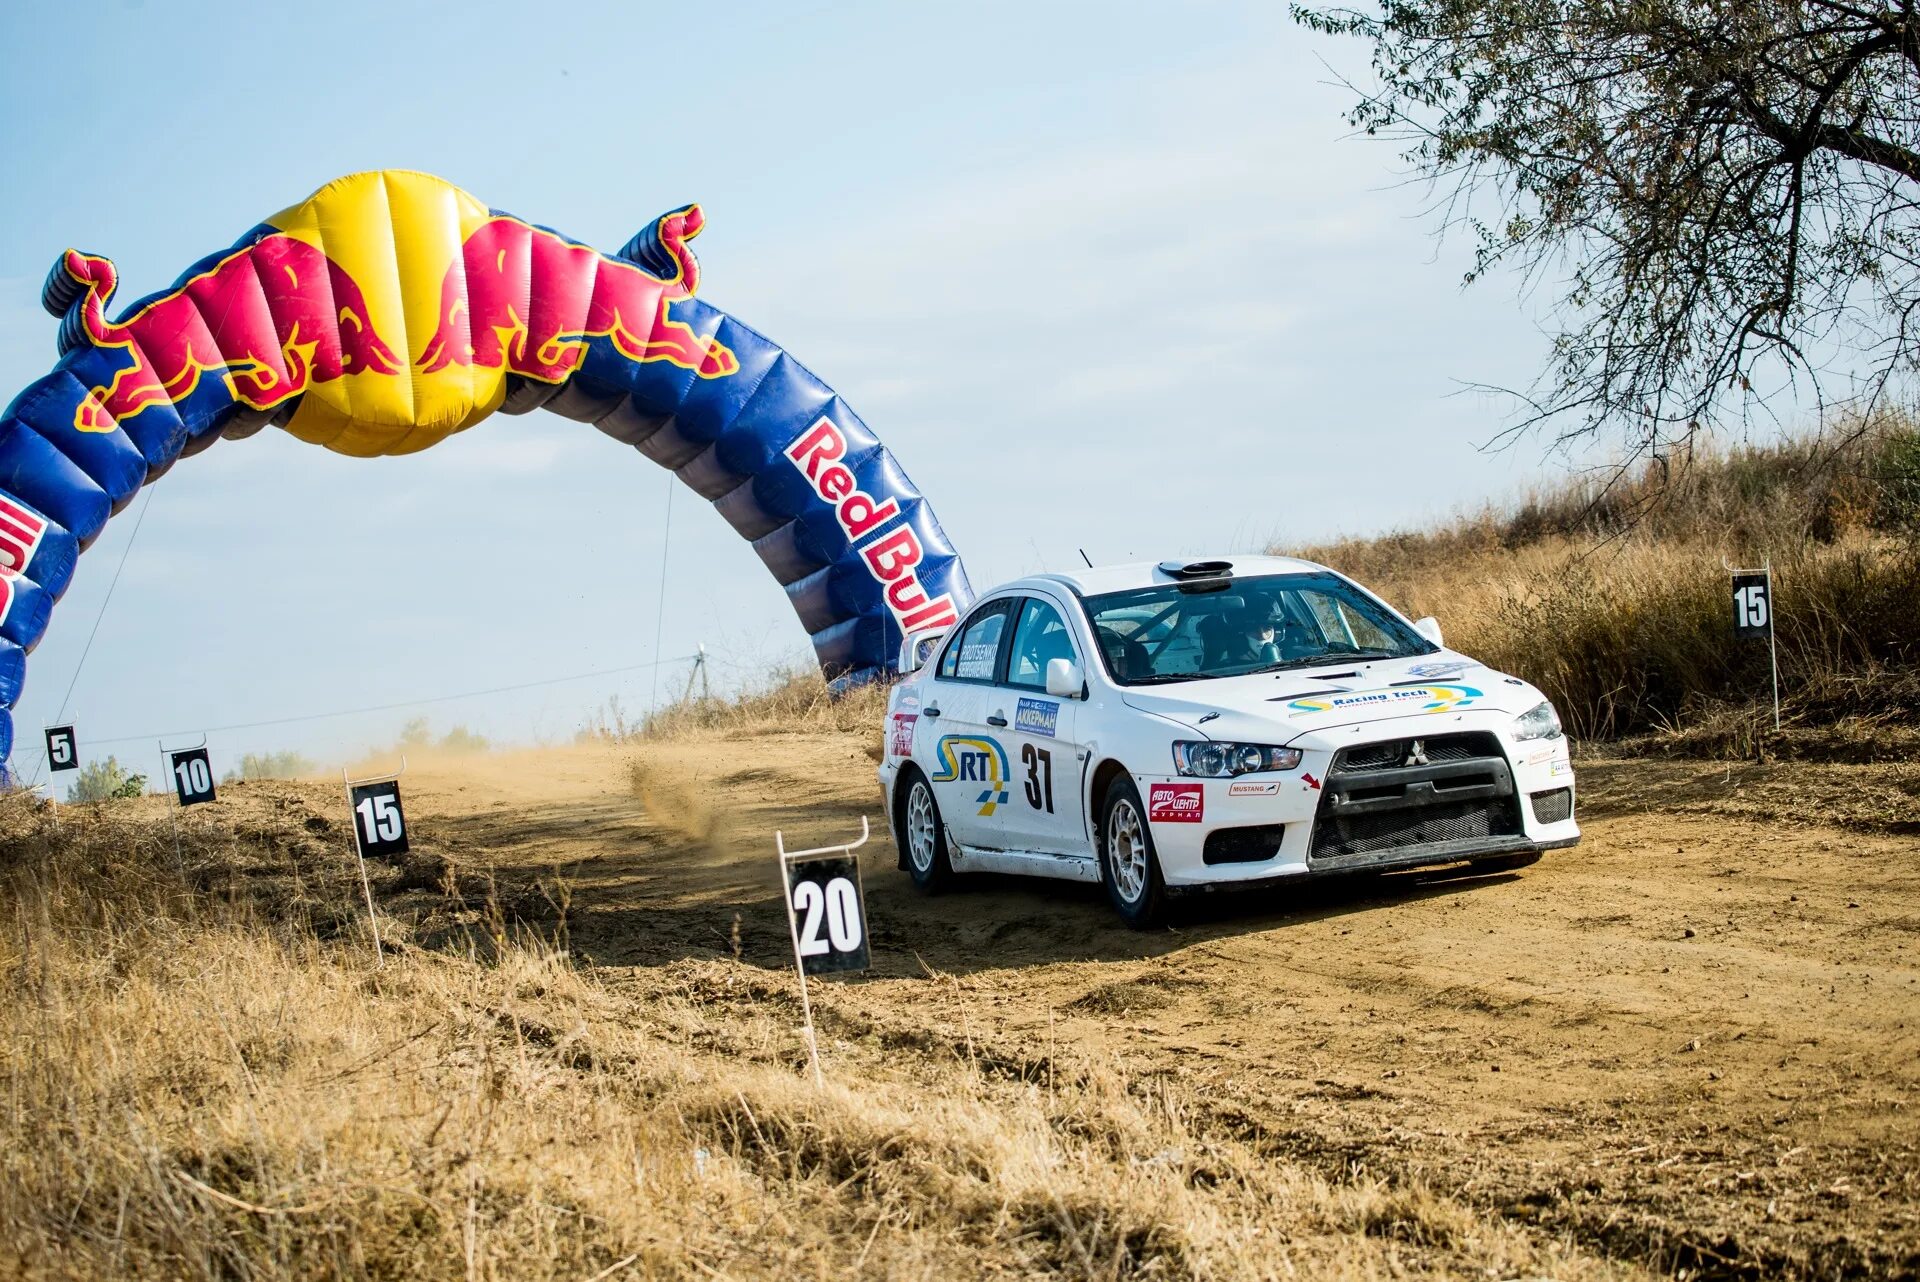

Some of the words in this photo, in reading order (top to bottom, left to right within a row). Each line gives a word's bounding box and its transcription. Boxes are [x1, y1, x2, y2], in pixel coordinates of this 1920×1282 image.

[788, 420, 899, 540] Red
[863, 527, 957, 636] Bull
[1734, 586, 1767, 627] 15
[1334, 694, 1387, 706] Racing
[1392, 690, 1428, 698] Tech
[1016, 708, 1057, 730] АККЕРМАН
[51, 734, 72, 764] 5
[932, 734, 991, 782] SRT
[175, 759, 211, 796] 10
[1021, 743, 1054, 814] 37
[1152, 791, 1174, 801] АВТО
[356, 794, 402, 844] 15
[1173, 799, 1200, 810] ЦЕНТР
[794, 877, 862, 957] 20
